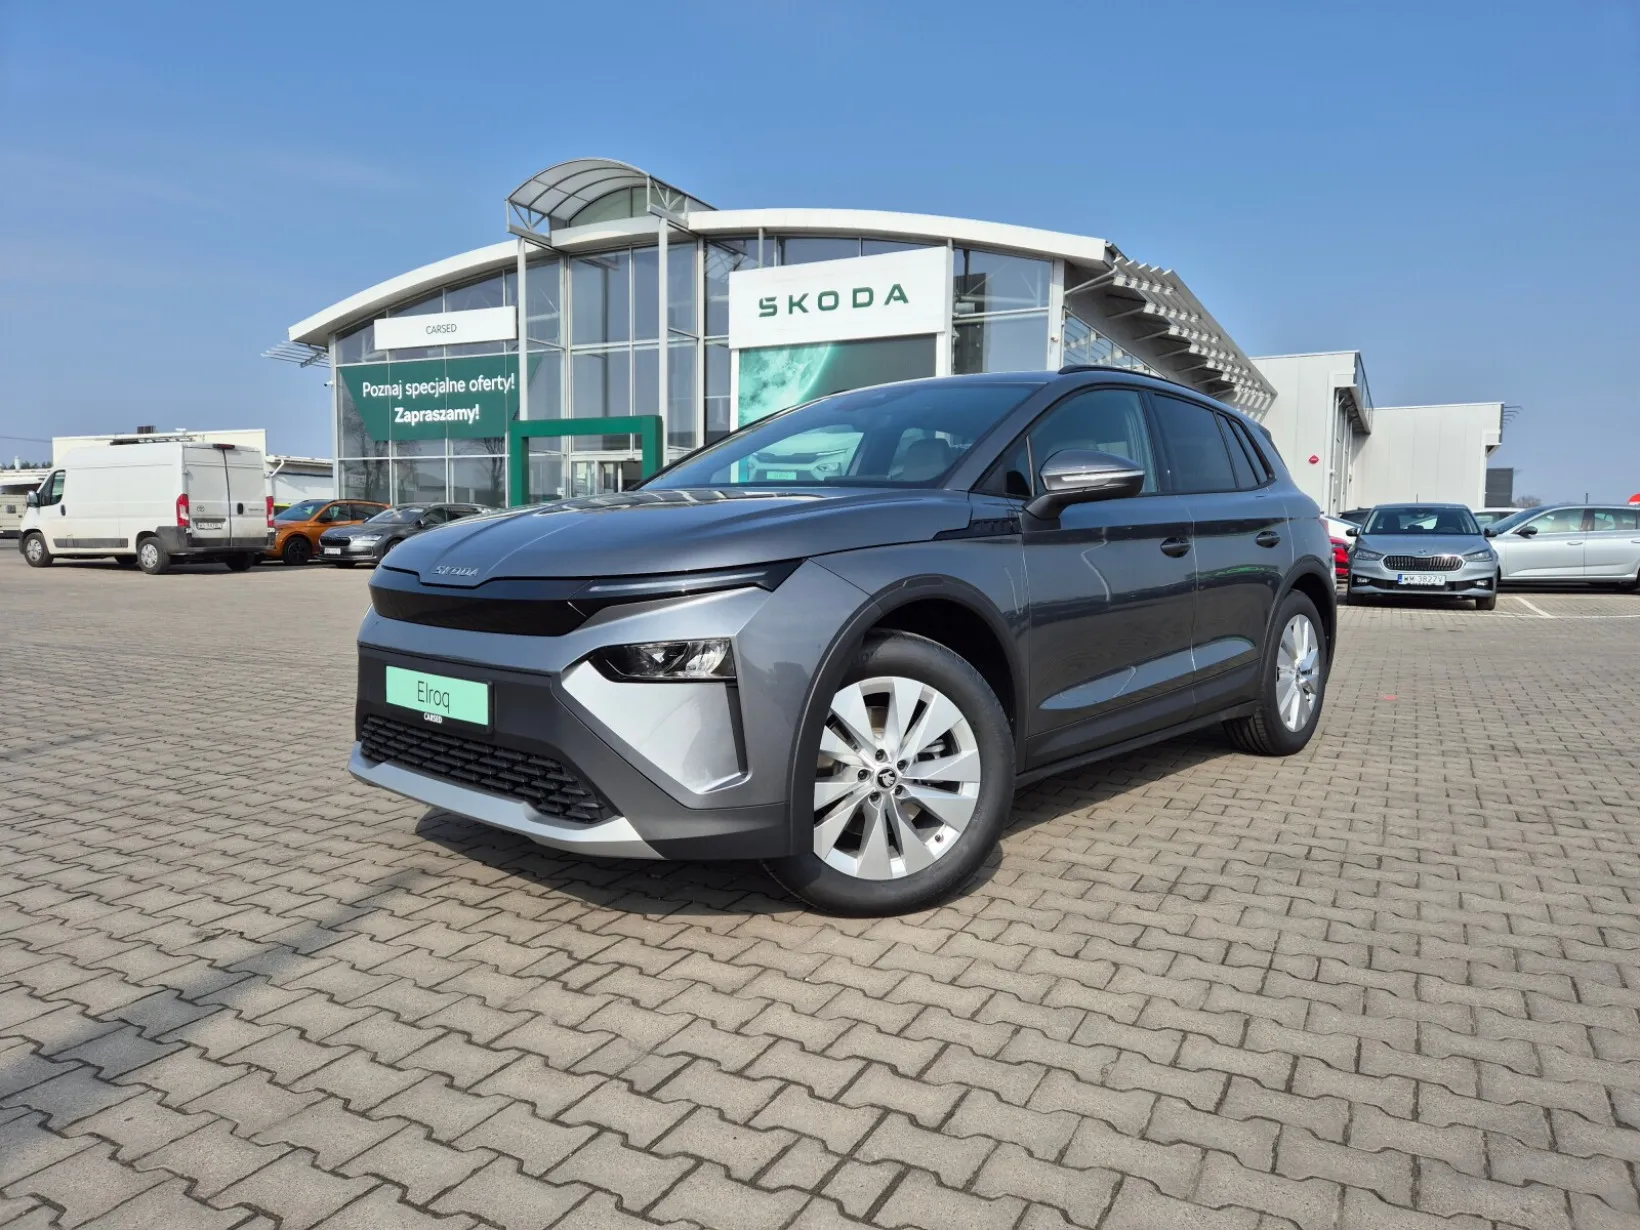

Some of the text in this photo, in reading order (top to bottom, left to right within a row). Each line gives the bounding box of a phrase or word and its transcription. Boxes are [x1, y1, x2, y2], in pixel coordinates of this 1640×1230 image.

[425, 323, 457, 335] CARSED
[362, 373, 515, 400] Poznaj specjalne oferty!
[394, 404, 480, 426] Zapraszamy!
[417, 680, 450, 714] Elroq
